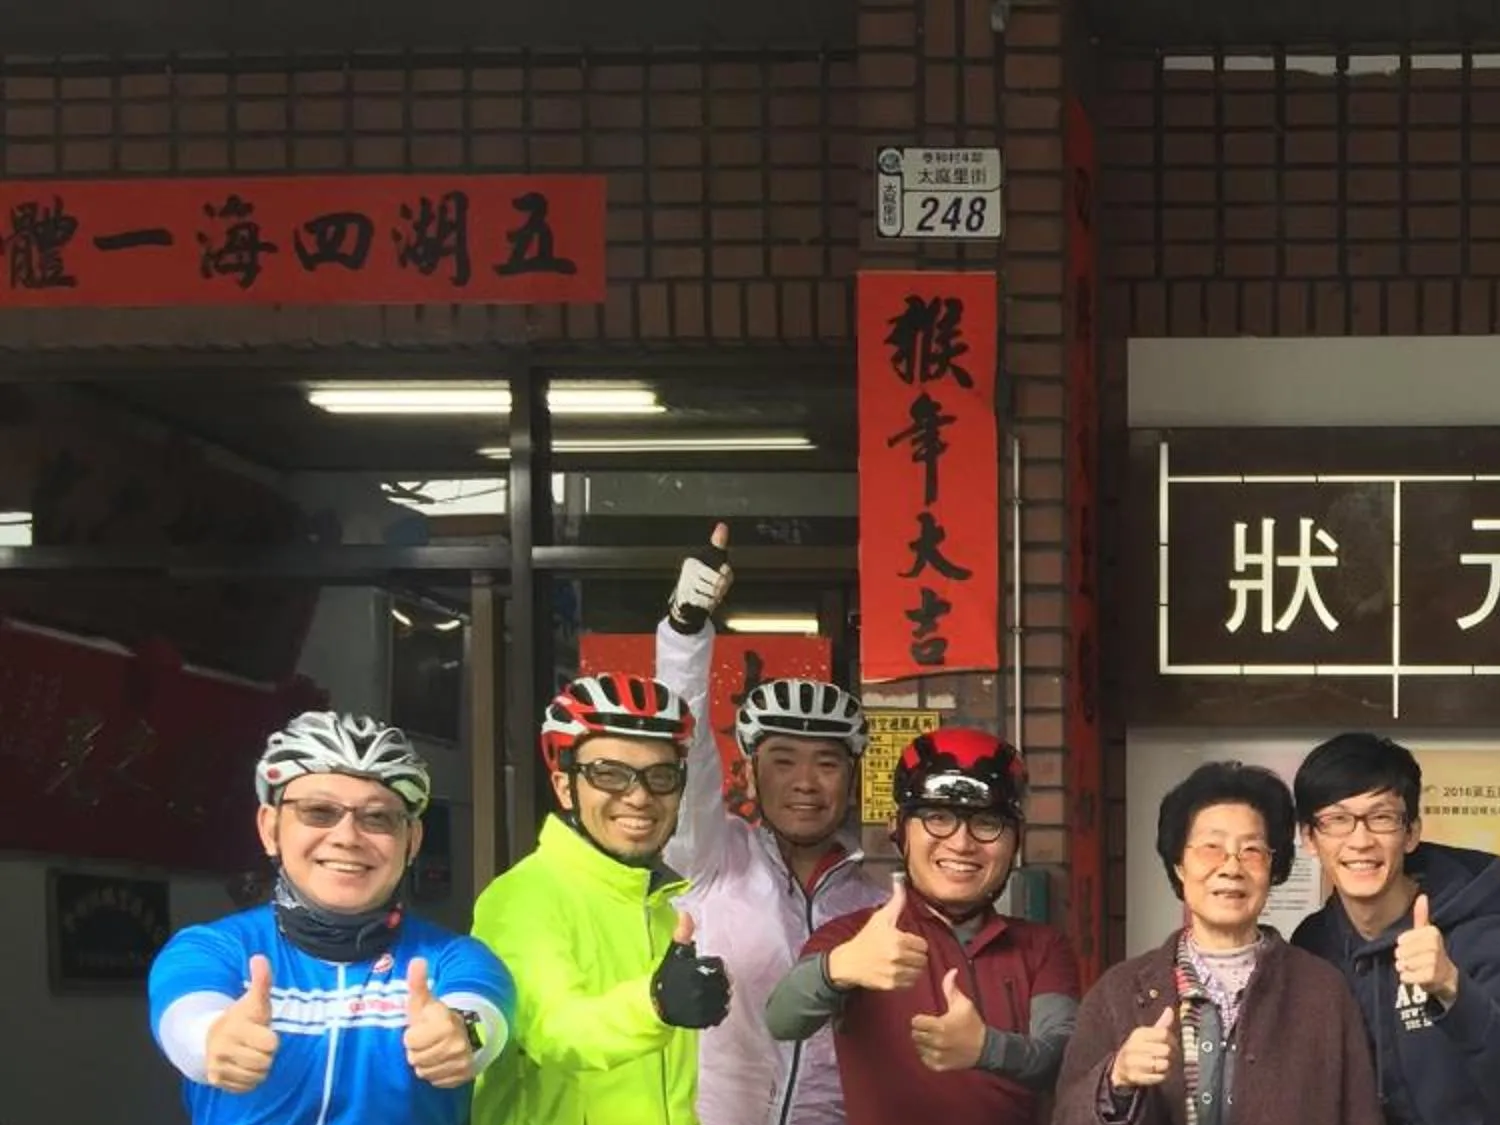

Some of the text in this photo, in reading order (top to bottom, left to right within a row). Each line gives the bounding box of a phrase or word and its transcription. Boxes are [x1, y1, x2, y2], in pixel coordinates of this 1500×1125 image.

[916, 196, 987, 233] 248
[882, 294, 975, 666] 猴年大吉
